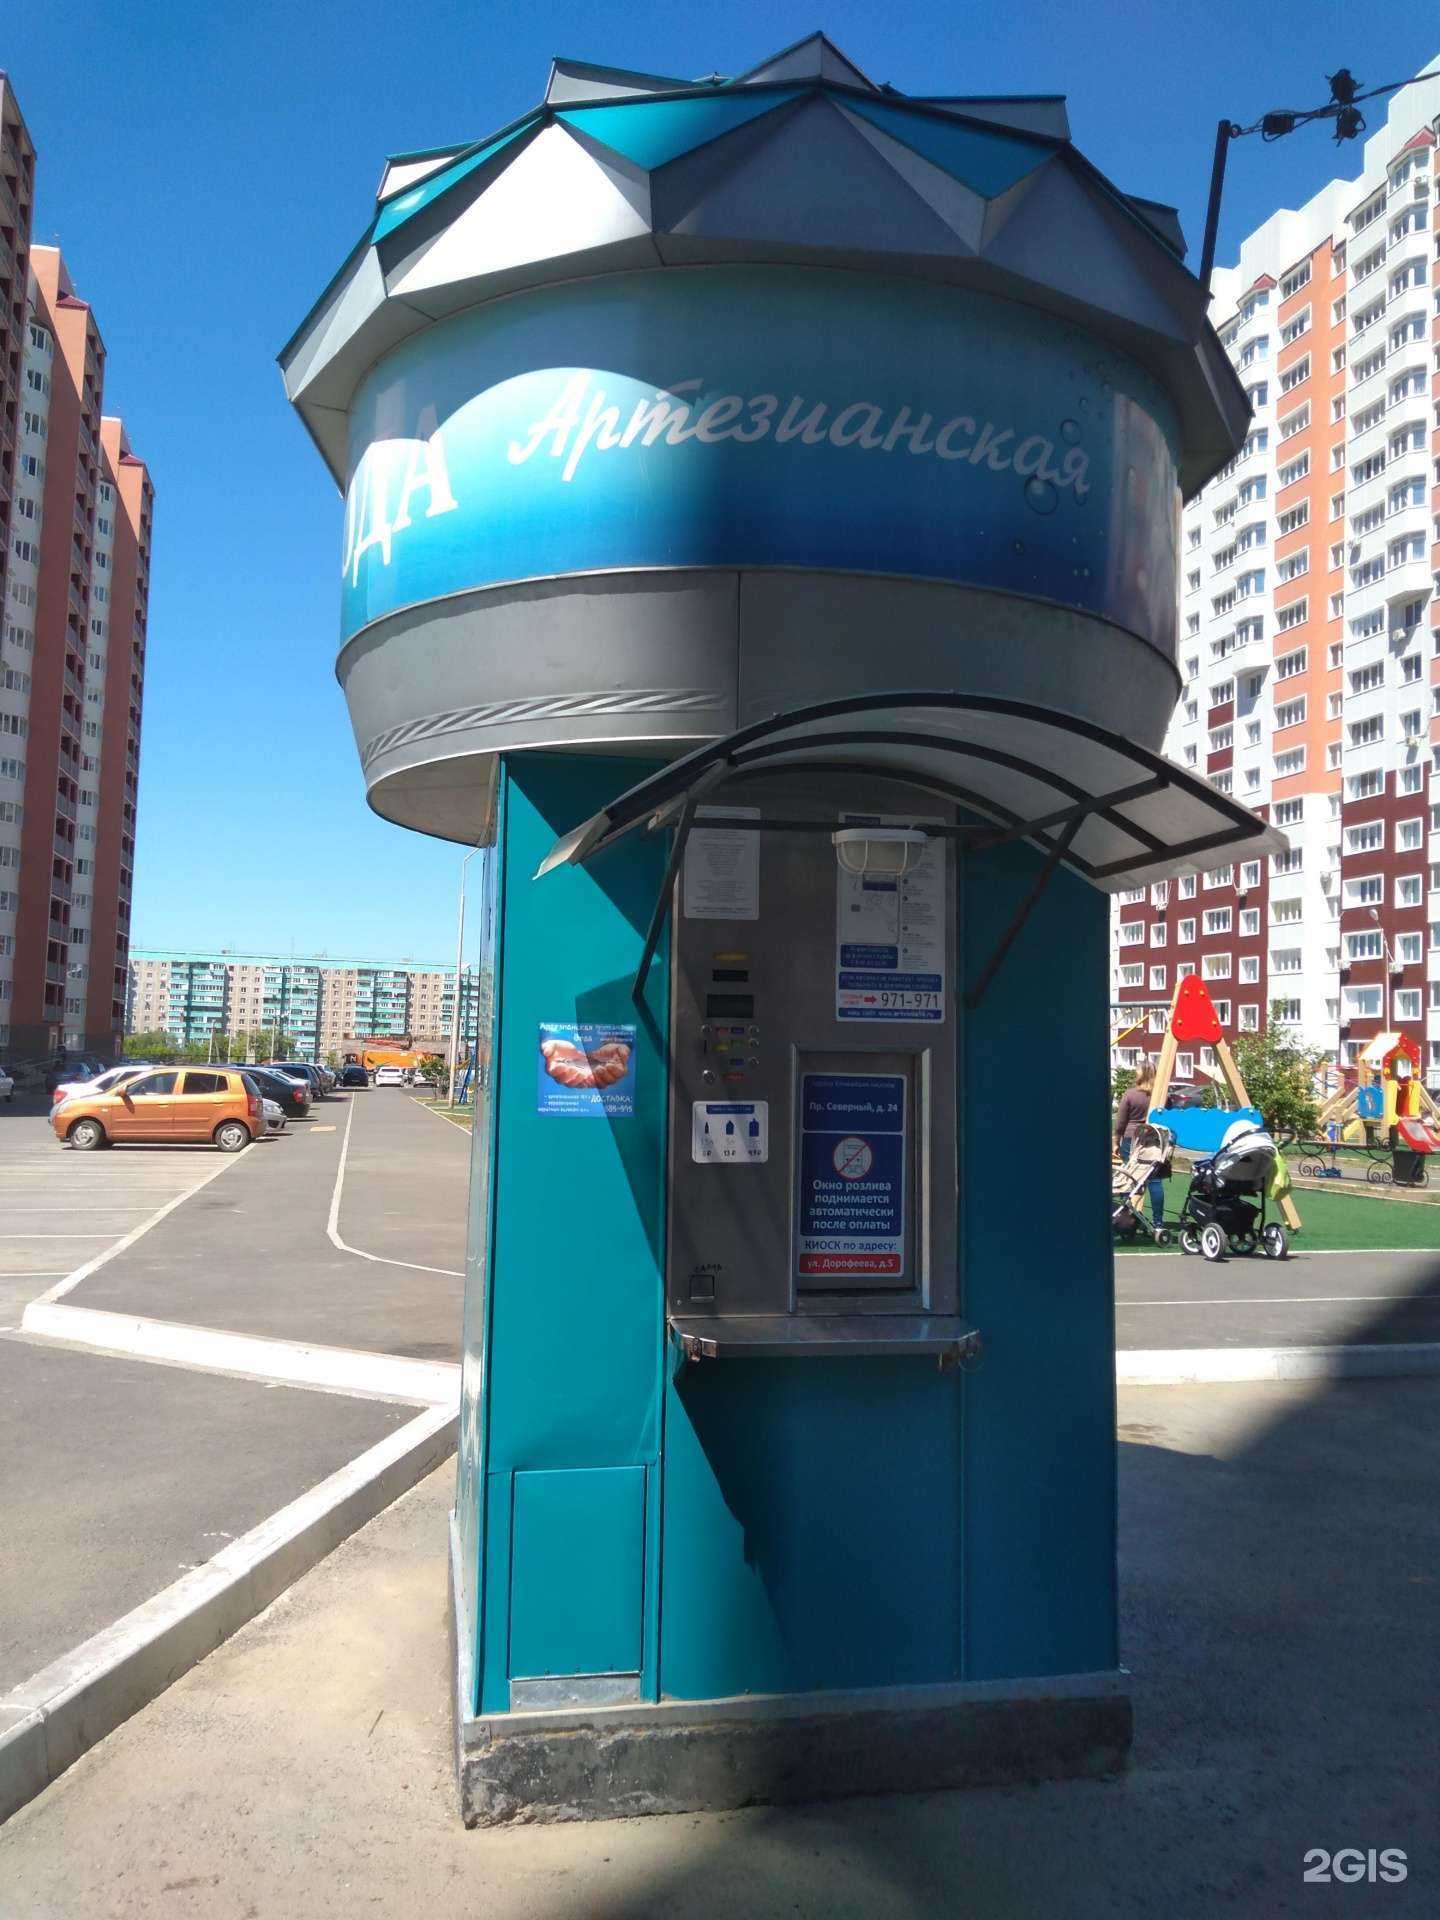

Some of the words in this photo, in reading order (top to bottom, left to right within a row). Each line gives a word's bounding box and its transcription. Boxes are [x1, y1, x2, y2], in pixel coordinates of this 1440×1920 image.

[508, 370, 1090, 493] Артезианская
[881, 992, 938, 1008] 971-971
[826, 1101, 875, 1113] Северный,
[812, 1179, 843, 1191] Окно
[845, 1181, 892, 1192] розлива
[814, 1194, 890, 1205] поднимается
[809, 1207, 894, 1217] автоматически
[813, 1220, 846, 1230] после
[849, 1220, 891, 1230] оплаты
[805, 1240, 841, 1250] КИОСК
[843, 1242, 856, 1250] по
[858, 1242, 897, 1252] адресу:
[807, 1260, 821, 1269] ул.
